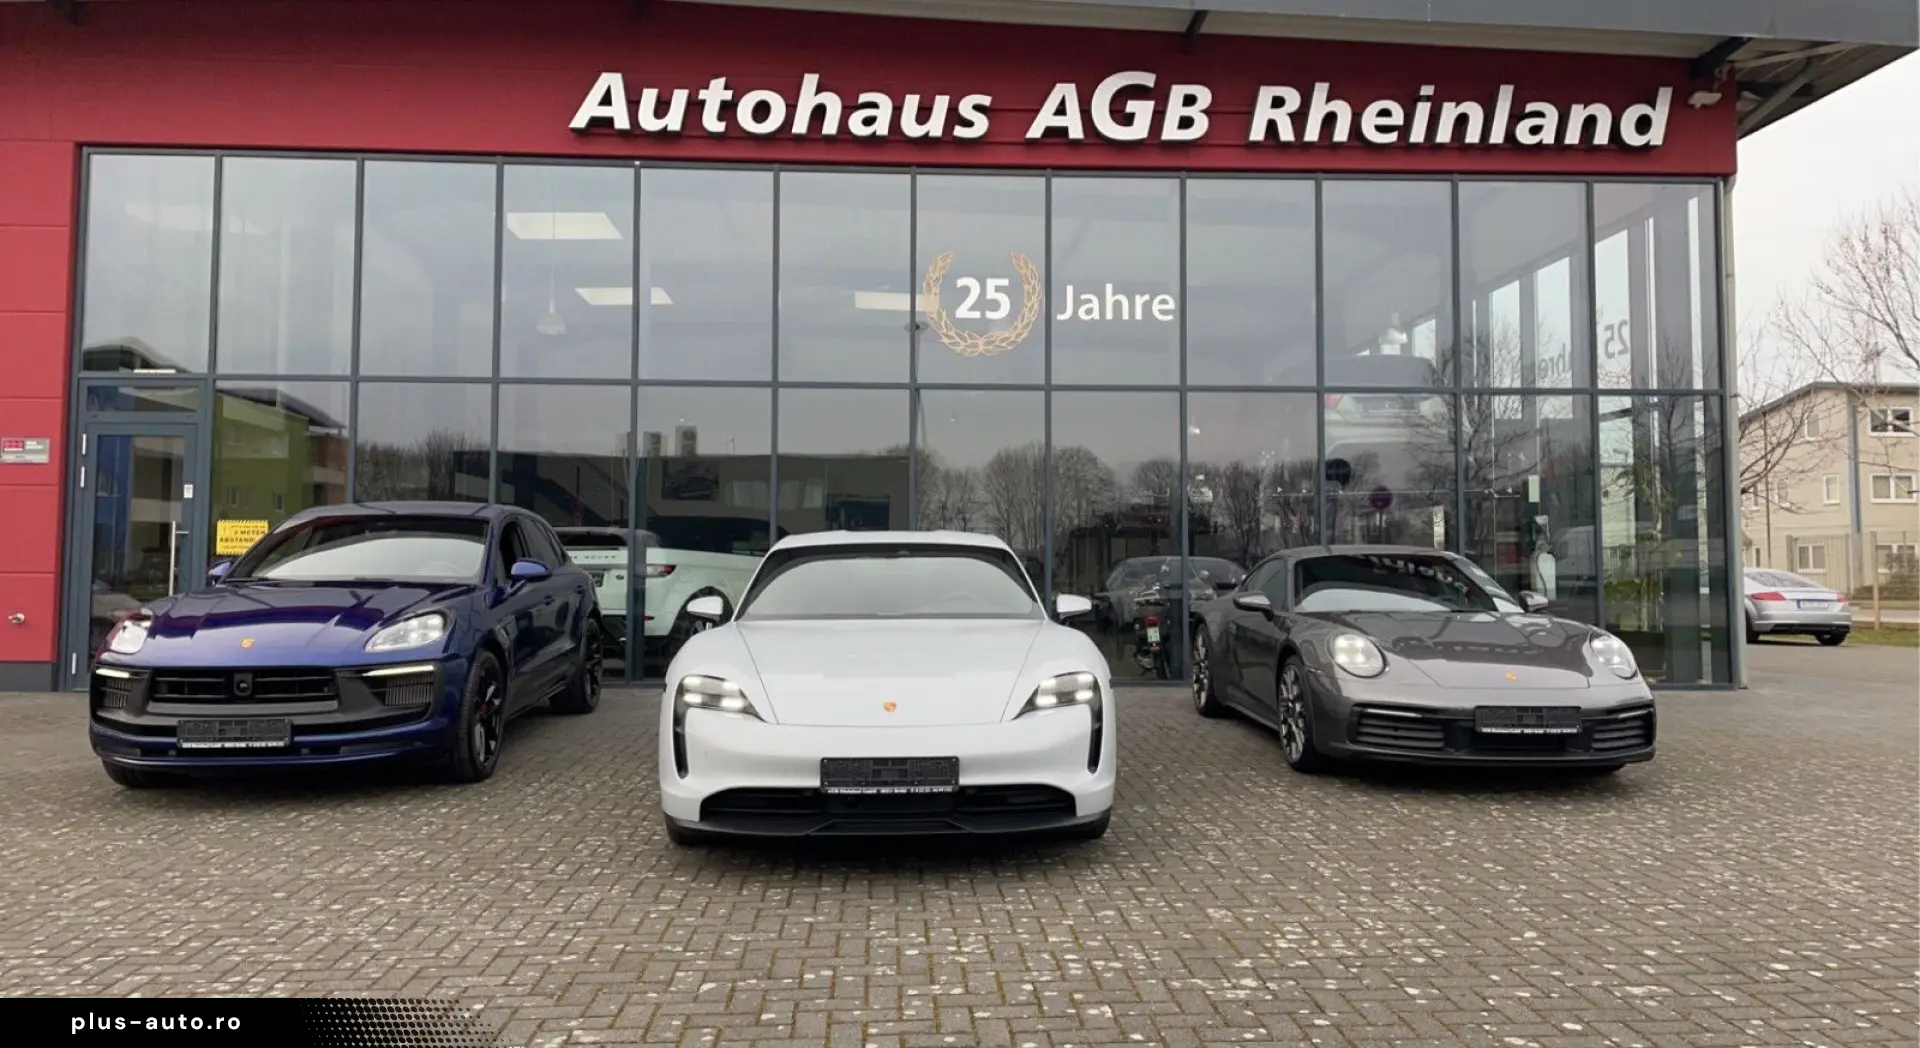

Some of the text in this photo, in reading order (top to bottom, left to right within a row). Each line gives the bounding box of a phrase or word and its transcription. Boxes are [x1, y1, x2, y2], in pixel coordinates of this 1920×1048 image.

[568, 69, 1674, 147] Autohaus AGB Rheinland
[954, 276, 1176, 321] 25 Jahre
